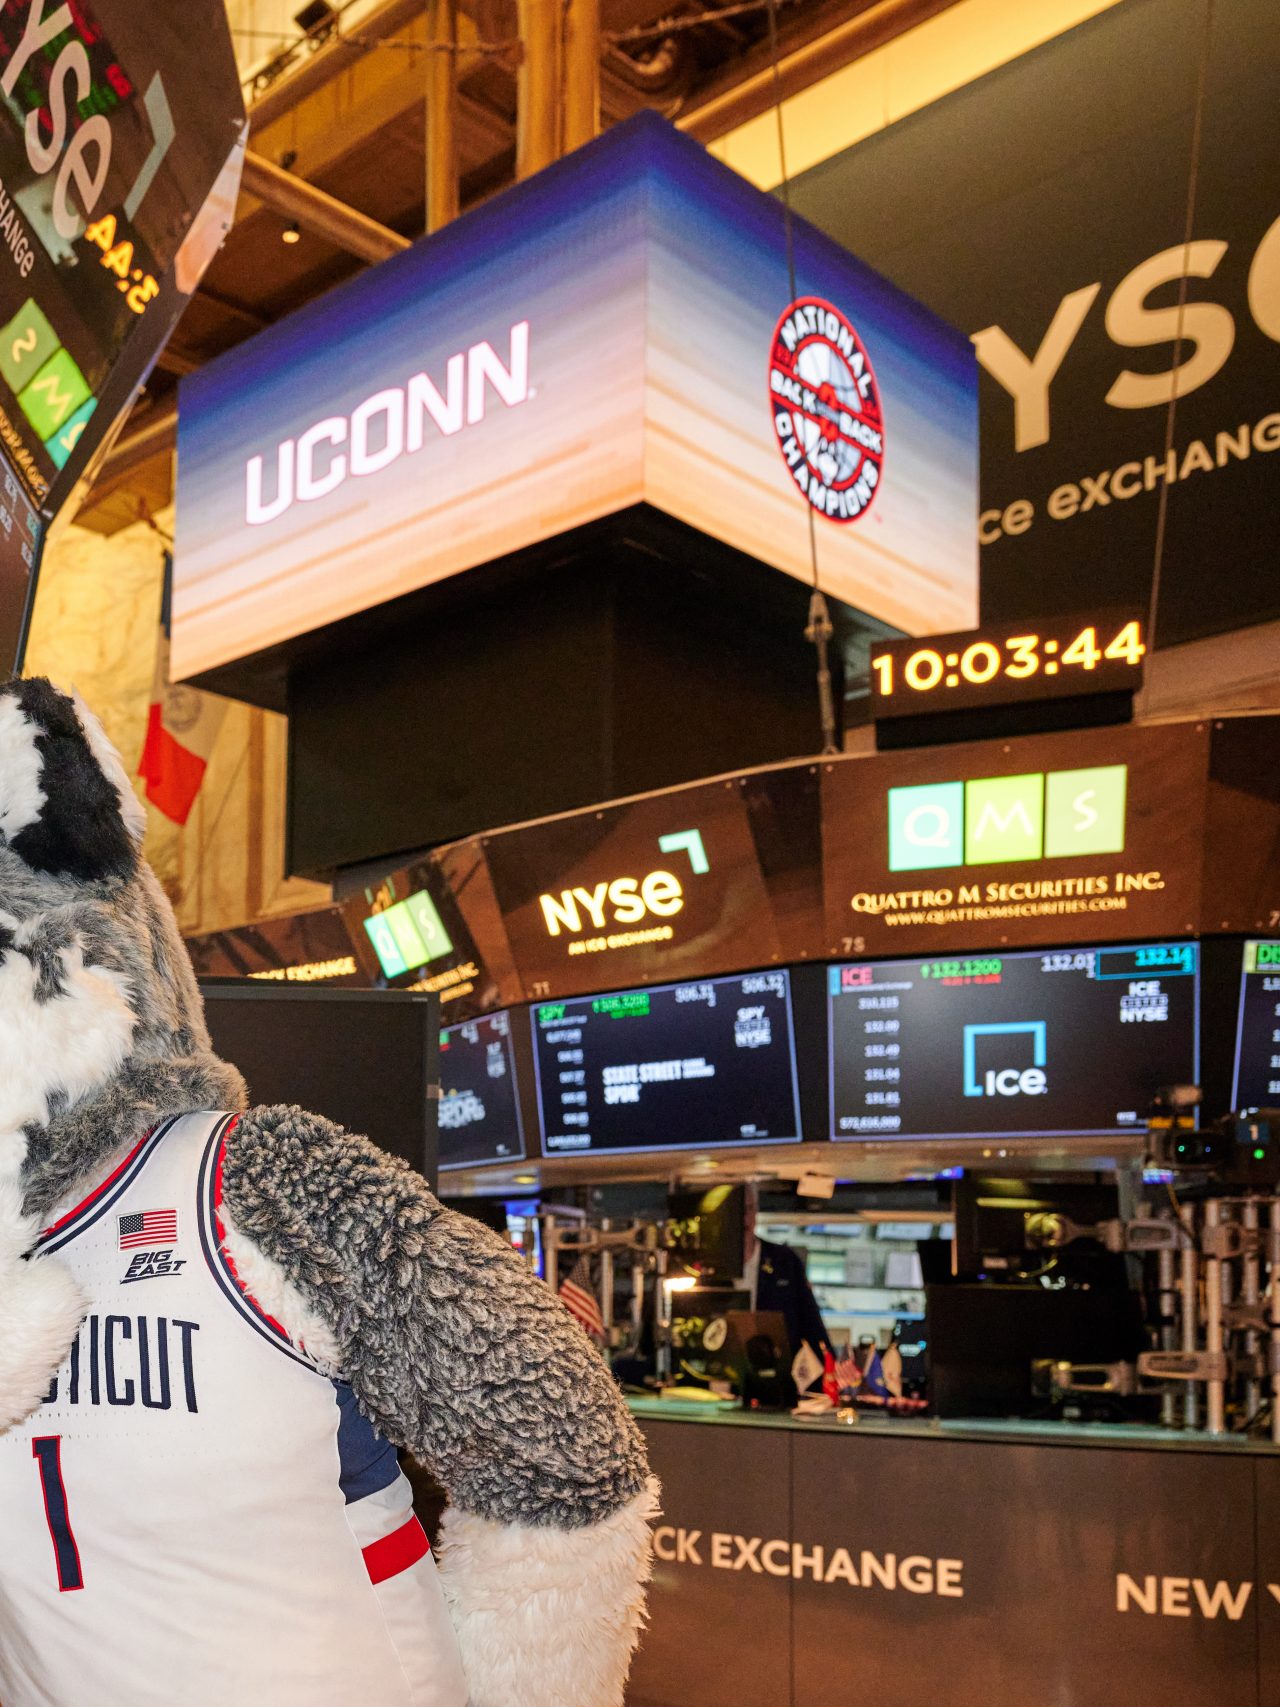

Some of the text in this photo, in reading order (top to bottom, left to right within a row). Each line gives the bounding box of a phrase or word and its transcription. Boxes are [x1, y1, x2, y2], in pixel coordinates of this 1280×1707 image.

[780, 305, 872, 398] NATIONAL
[245, 320, 530, 526] UCONN
[770, 368, 817, 413] BACK
[839, 411, 882, 453] BACK
[774, 411, 879, 518] CHAMPIONS
[873, 621, 1146, 696] 10:03:44
[958, 885, 980, 905] M
[986, 876, 1109, 903] SECURITIES
[841, 966, 873, 986] ICE
[1128, 980, 1161, 998] ICE
[1120, 1005, 1168, 1023] NYSE
[602, 1064, 639, 1086] STATE
[639, 1060, 682, 1083] STREET
[125, 1260, 188, 1279] EAST
[131, 1250, 174, 1267] BIG
[32, 1434, 84, 1592] 1
[711, 1533, 965, 1598] EXCHANGE
[1116, 1572, 1252, 1620] NEW
